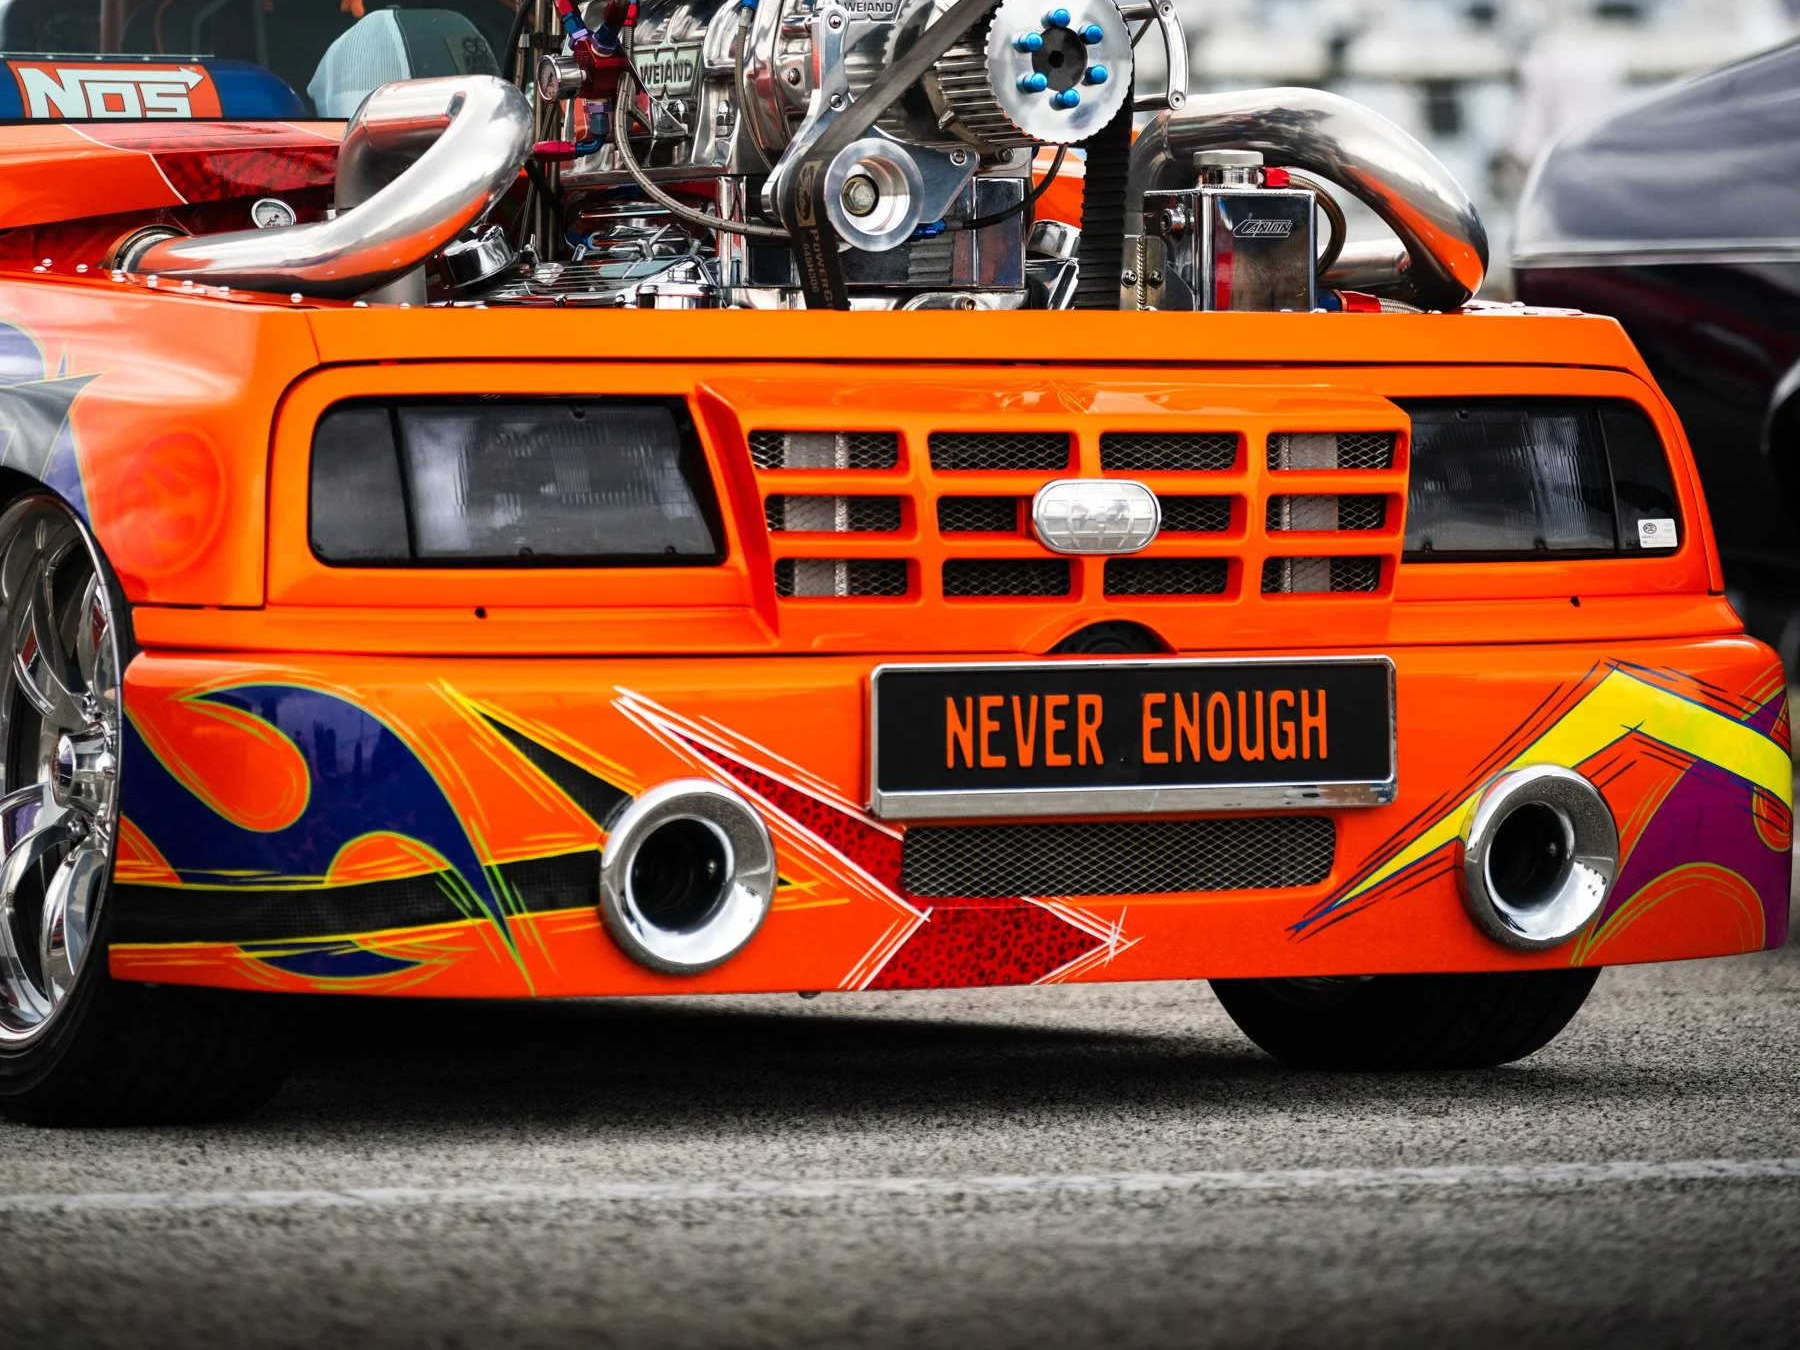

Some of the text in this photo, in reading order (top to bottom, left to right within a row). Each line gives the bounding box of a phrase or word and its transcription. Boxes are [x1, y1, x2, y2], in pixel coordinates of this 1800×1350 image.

[844, 2, 893, 12] WEIAND
[640, 59, 694, 85] WEIAND
[17, 66, 204, 118] NOS
[945, 689, 1328, 768] NEVER ENOUGH
